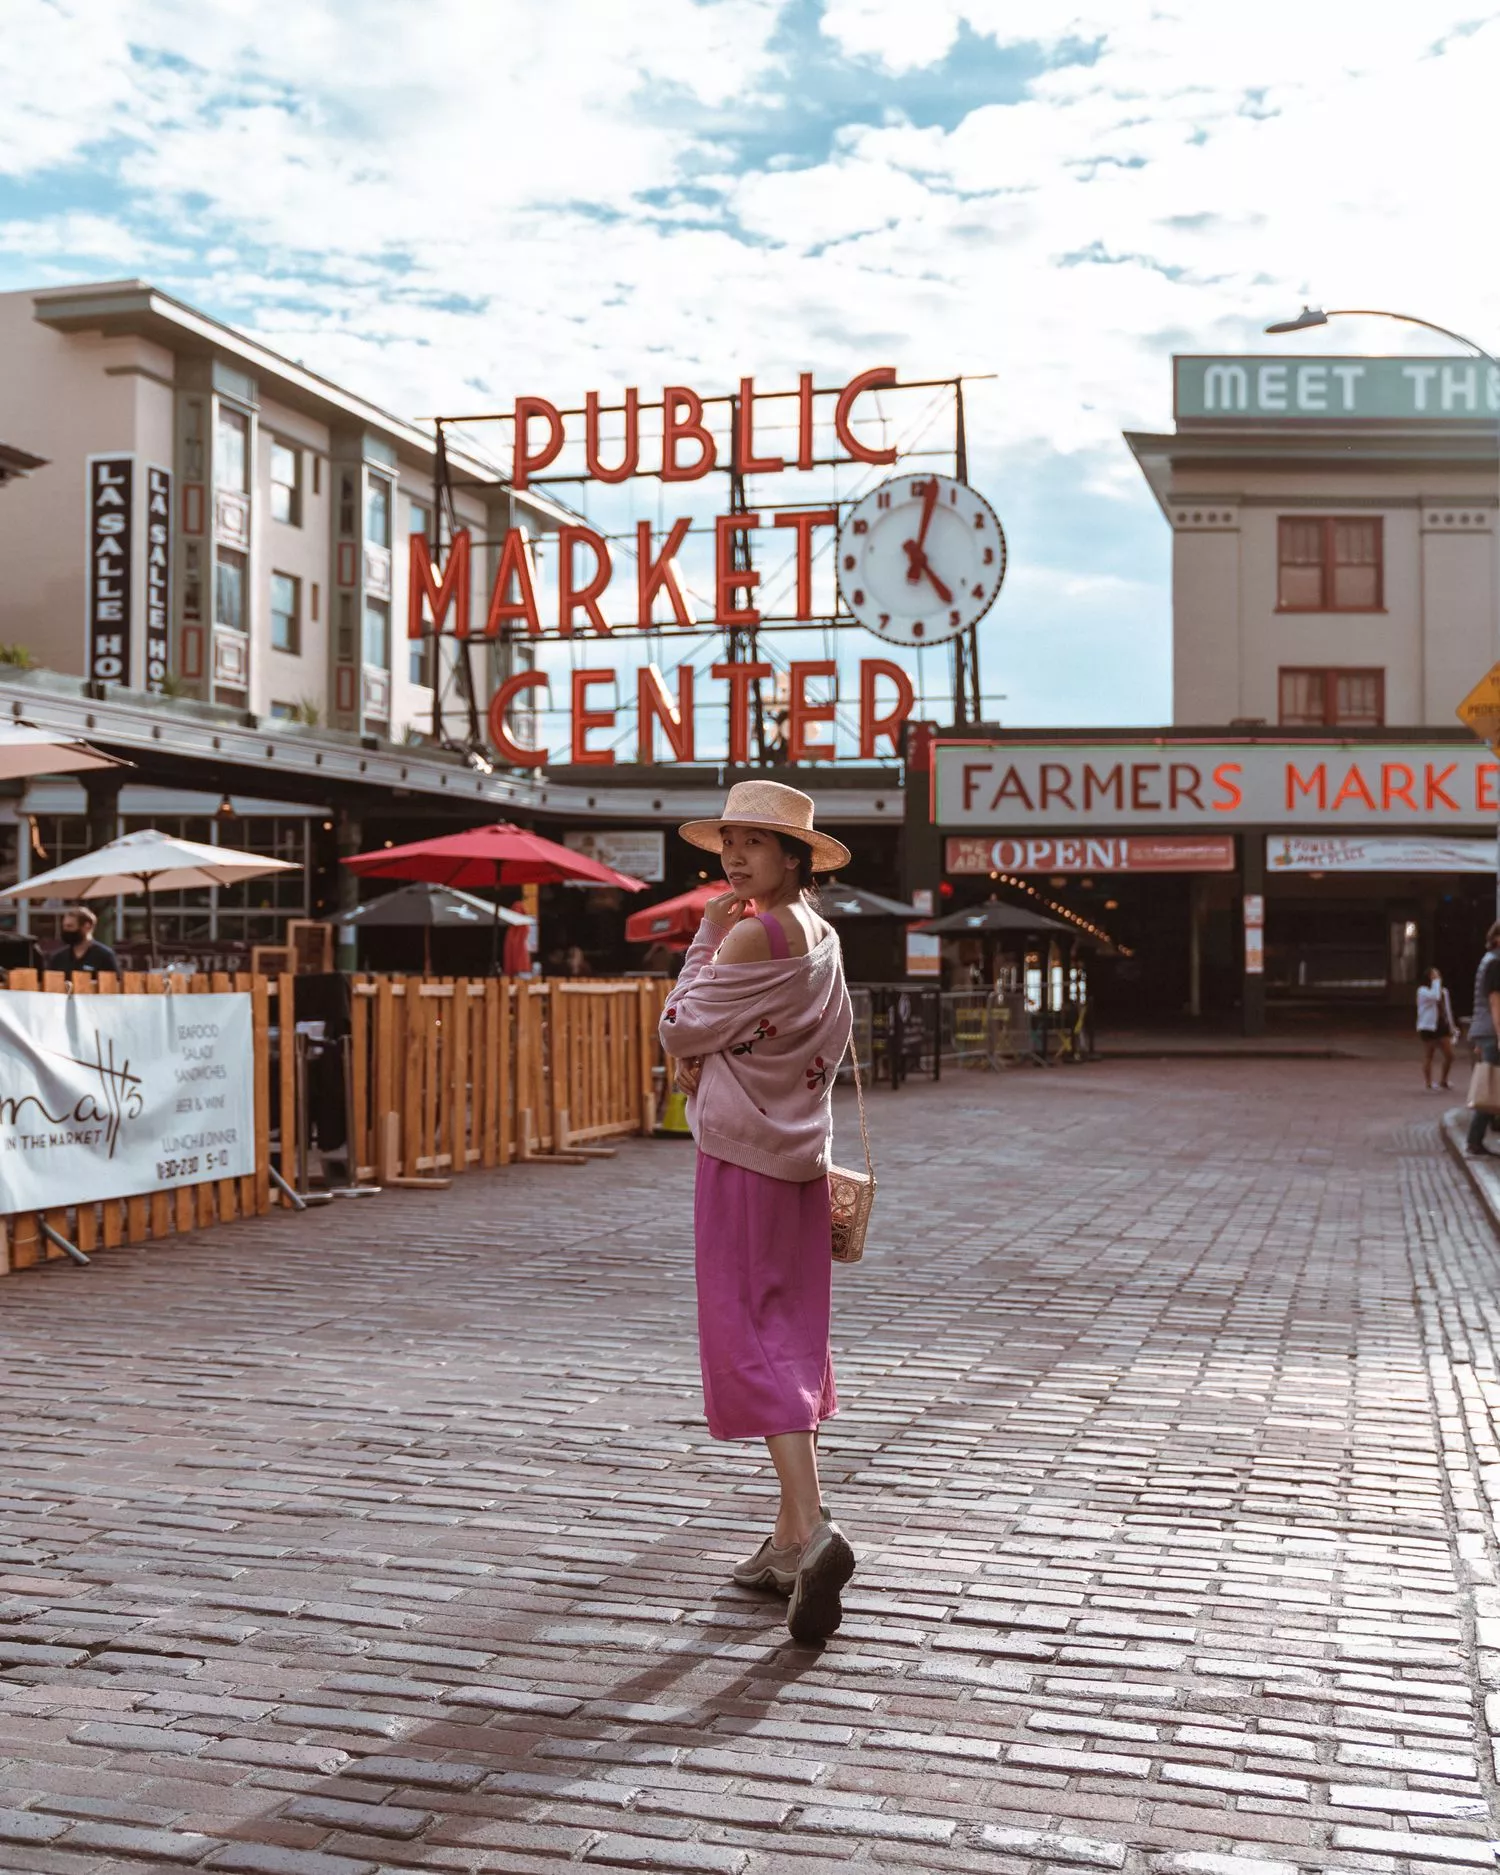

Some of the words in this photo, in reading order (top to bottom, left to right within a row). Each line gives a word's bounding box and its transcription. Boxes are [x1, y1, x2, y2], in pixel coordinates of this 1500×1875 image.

[1203, 364, 1365, 411] MEET
[511, 367, 897, 490] PUBLIC
[96, 464, 125, 506] LA
[150, 471, 167, 515] LA
[878, 492, 890, 509] 11
[853, 519, 868, 535] 10
[974, 512, 985, 529] 2
[844, 555, 856, 571] 9
[983, 547, 993, 565] 3
[95, 513, 126, 620] SALLE
[408, 510, 836, 639] MARKET
[149, 524, 166, 629] SALLE
[853, 589, 864, 606] 8
[971, 583, 984, 600] 4
[879, 613, 890, 630] 7
[950, 610, 960, 627] 5
[912, 621, 924, 638] 6
[488, 659, 914, 766] CENTER
[962, 763, 1242, 811] FARMERS
[1285, 763, 1498, 811] MARKE
[960, 841, 986, 855] WE
[991, 839, 1129, 869] OPEN!
[954, 855, 988, 870] ARE
[177, 1024, 219, 1040] SEAFOOD
[20, 1134, 46, 1150] THE
[49, 1130, 103, 1147] MARKET
